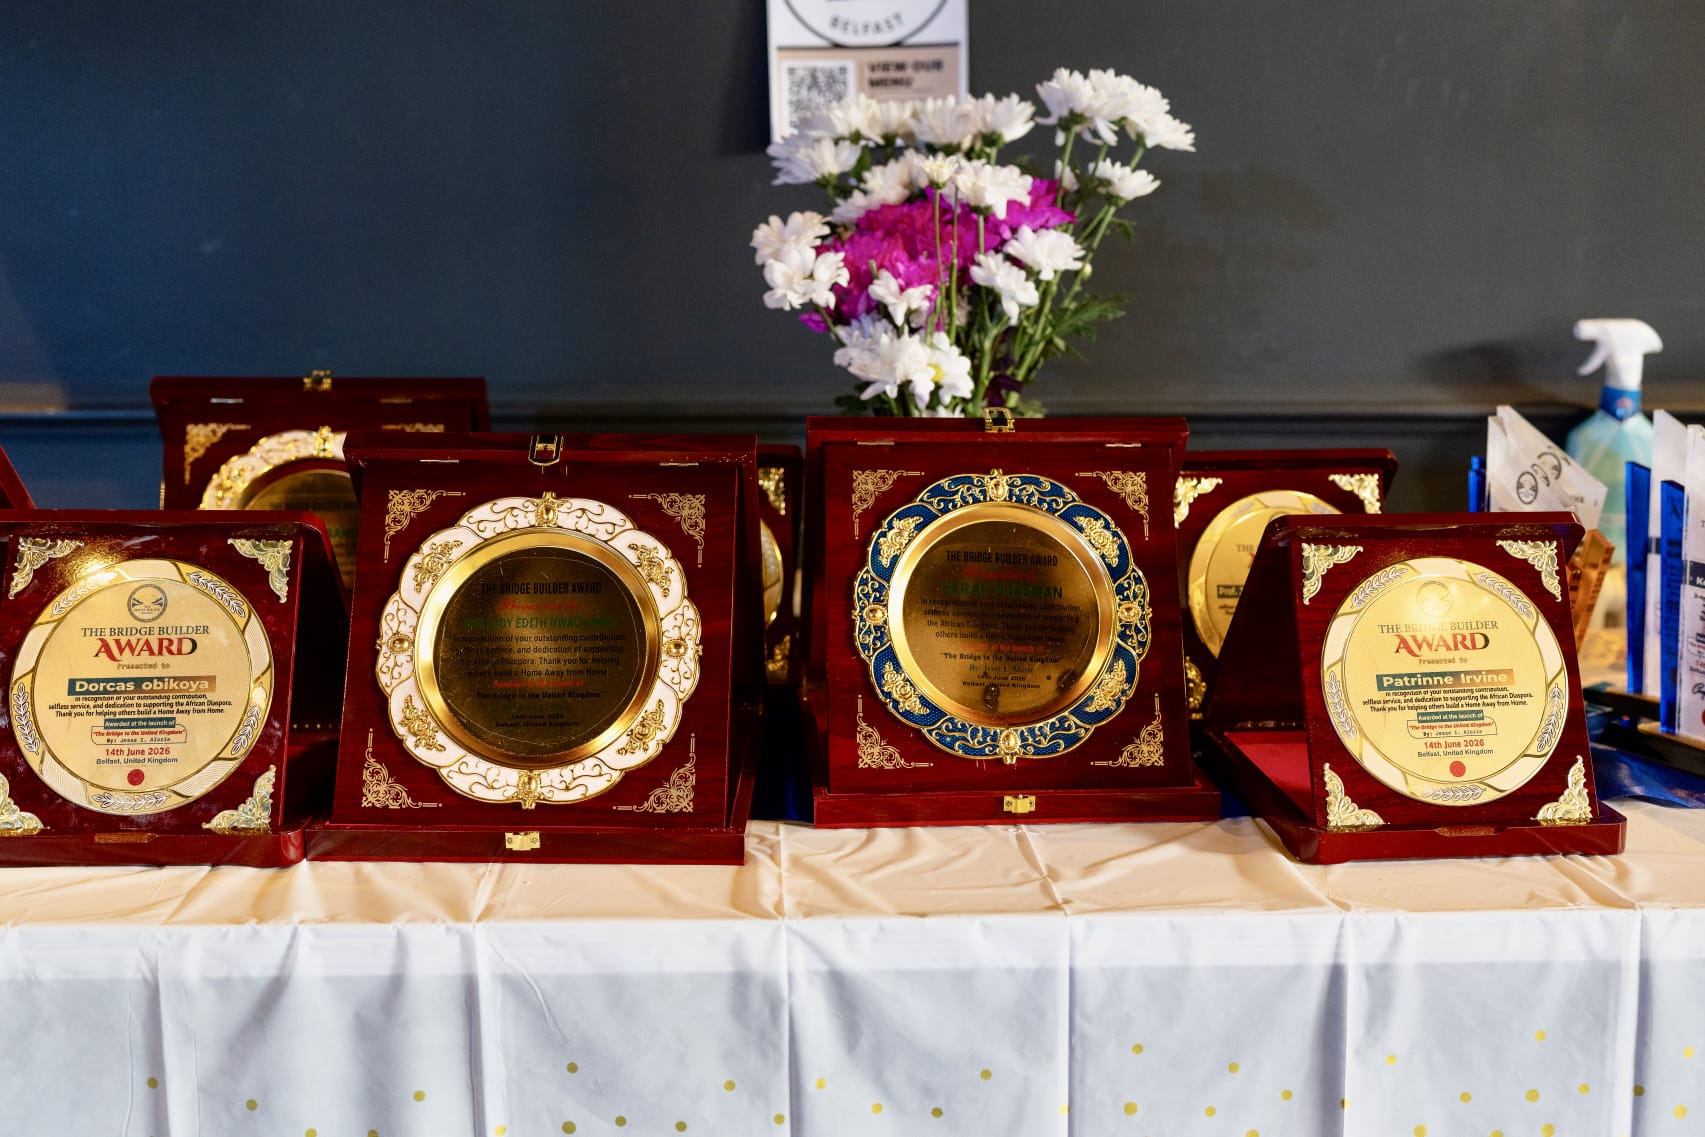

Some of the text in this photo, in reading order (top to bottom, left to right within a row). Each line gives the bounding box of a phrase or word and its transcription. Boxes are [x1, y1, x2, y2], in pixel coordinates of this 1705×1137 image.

[830, 13, 903, 35] BELFAST
[867, 59, 944, 73] VIEW OUR
[868, 76, 913, 89] MENU
[946, 551, 1058, 567] THE BRIDGE BUILDER AWARD
[500, 582, 531, 595] BRIDGE
[533, 582, 569, 594] BUILDER
[571, 581, 602, 594] AWARD
[516, 616, 547, 629] EDITH
[1377, 624, 1403, 634] THE
[1450, 620, 1499, 631] BUILDER
[81, 625, 210, 637] THE BRIDGE BUILDER
[935, 631, 958, 639] others
[533, 634, 578, 643] outstanding
[93, 637, 198, 663] AWARD
[532, 645, 572, 654] dedication
[1393, 632, 1490, 658] AWARD
[116, 662, 171, 670] Presented to
[538, 657, 561, 665] Thank
[563, 658, 577, 666] you
[544, 669, 565, 677] Away
[75, 677, 209, 692] Dorcas obikoya
[1382, 671, 1508, 688] Patrinne Irvine
[82, 695, 114, 703] recognition
[122, 695, 136, 703] your
[136, 693, 170, 702] outstanding
[1391, 689, 1423, 698] recognition
[1429, 689, 1442, 697] your
[1442, 687, 1475, 695] outstanding
[48, 702, 70, 710] selfless
[104, 701, 135, 709] dedication
[142, 700, 174, 709] supporting
[185, 699, 206, 707] African
[1362, 698, 1382, 706] selfless
[1449, 694, 1479, 702] supporting
[95, 709, 117, 718] helping
[175, 708, 191, 716] Away
[1406, 704, 1428, 712] helping
[1424, 739, 1485, 749] 14th June 2026
[105, 747, 171, 756] 14th June 2026
[1442, 749, 1464, 757] United
[1464, 748, 1494, 757] Kingdom
[147, 757, 178, 765] Kingdom
